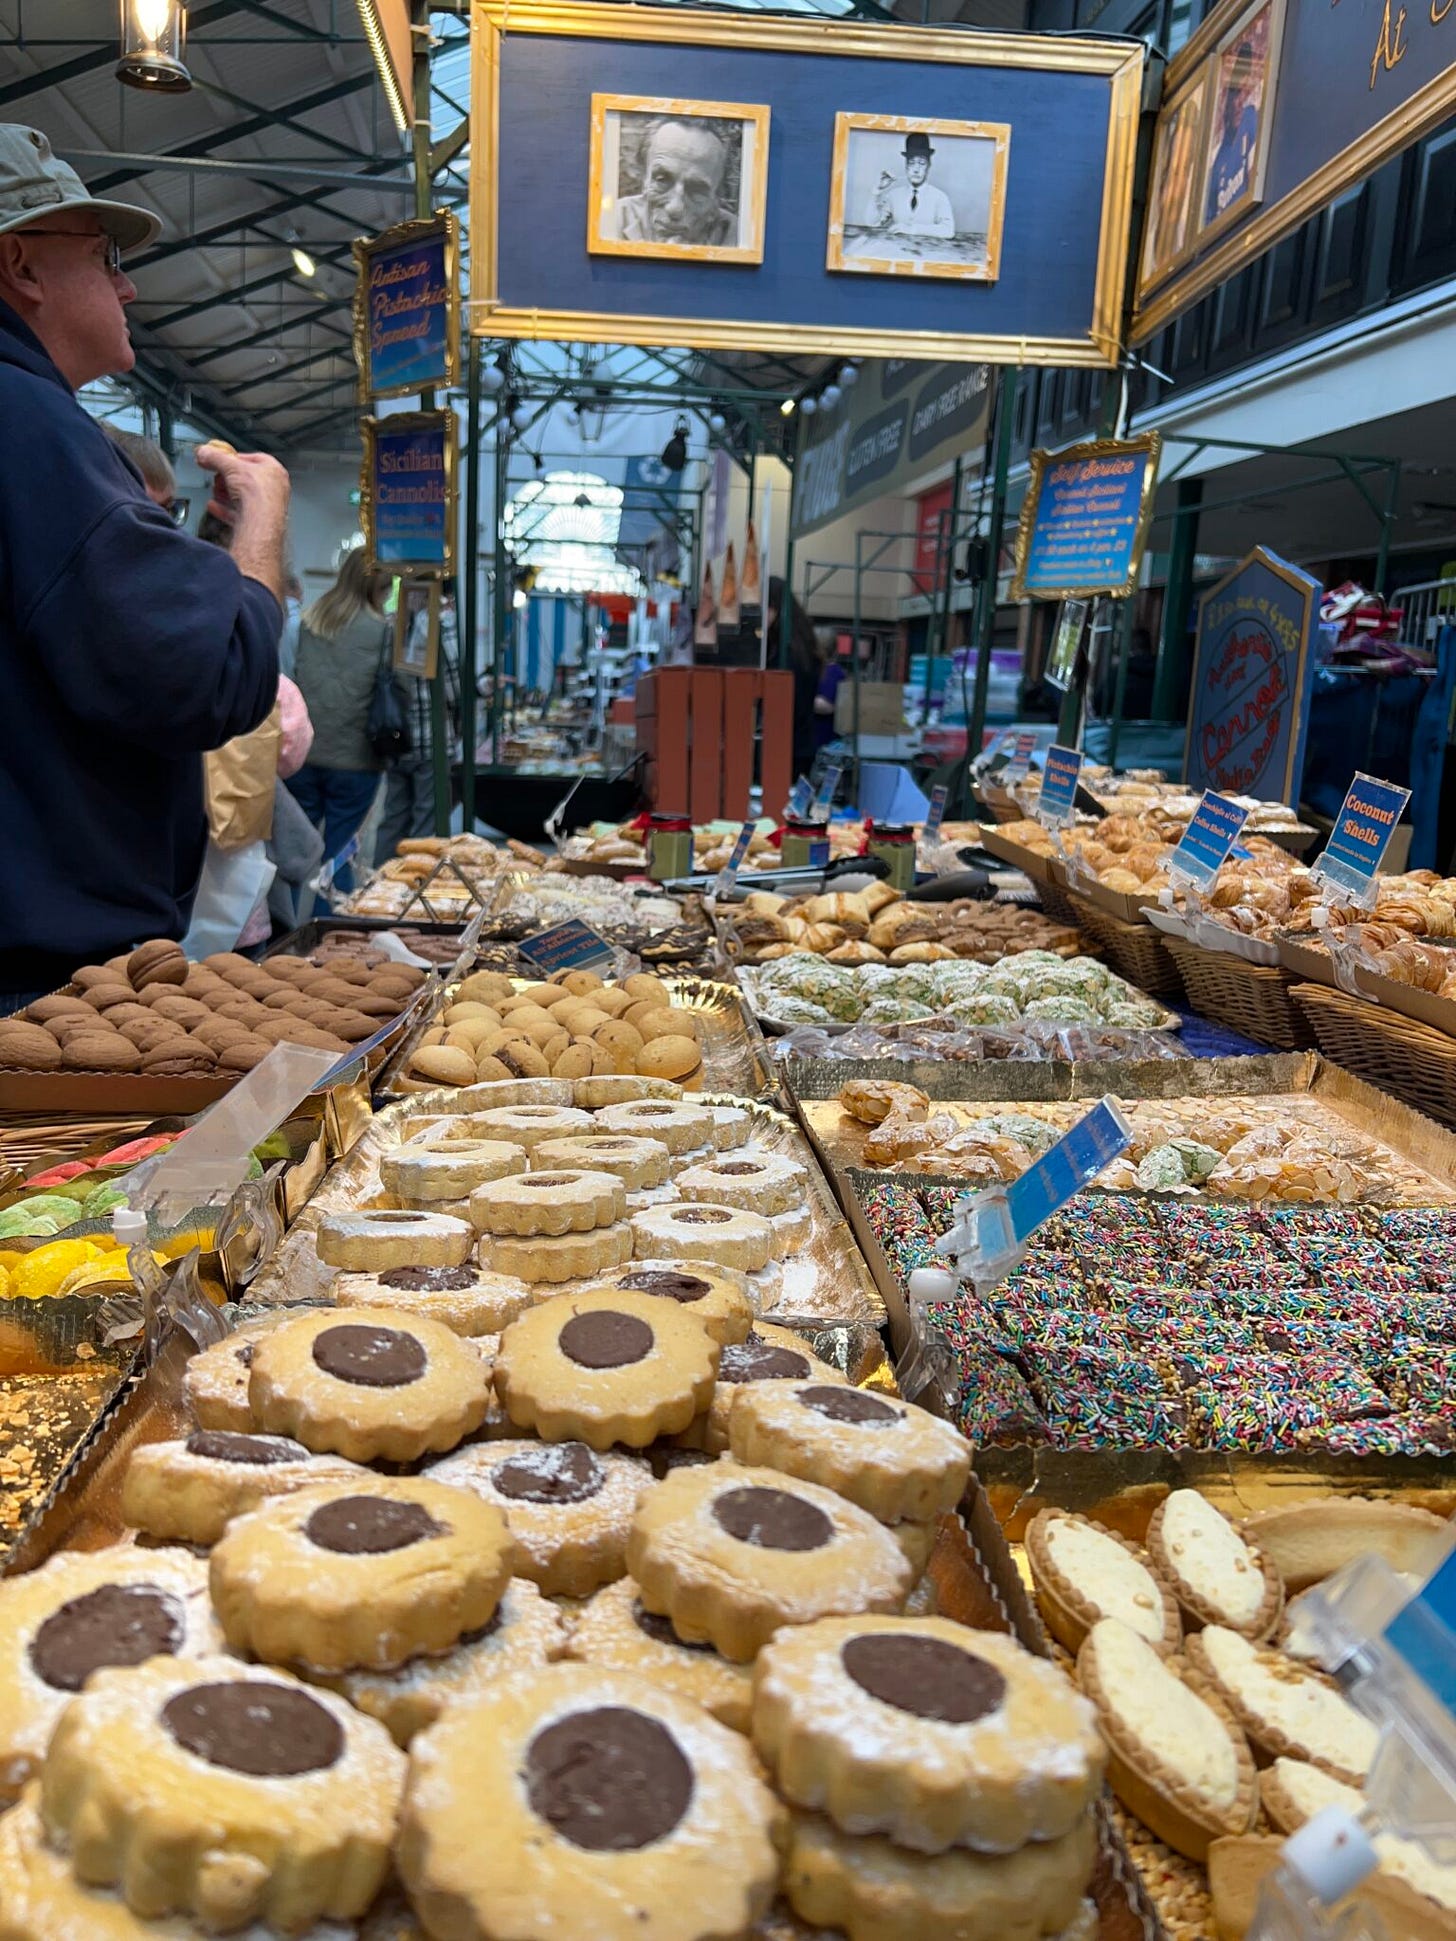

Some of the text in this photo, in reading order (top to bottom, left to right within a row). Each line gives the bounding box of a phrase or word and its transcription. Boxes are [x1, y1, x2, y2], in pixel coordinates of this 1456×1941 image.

[371, 260, 430, 289] Artisan
[380, 448, 442, 474] Sicilian
[1080, 459, 1136, 483] Service
[1346, 794, 1394, 825] Coconut
[1343, 819, 1380, 846] Shells
